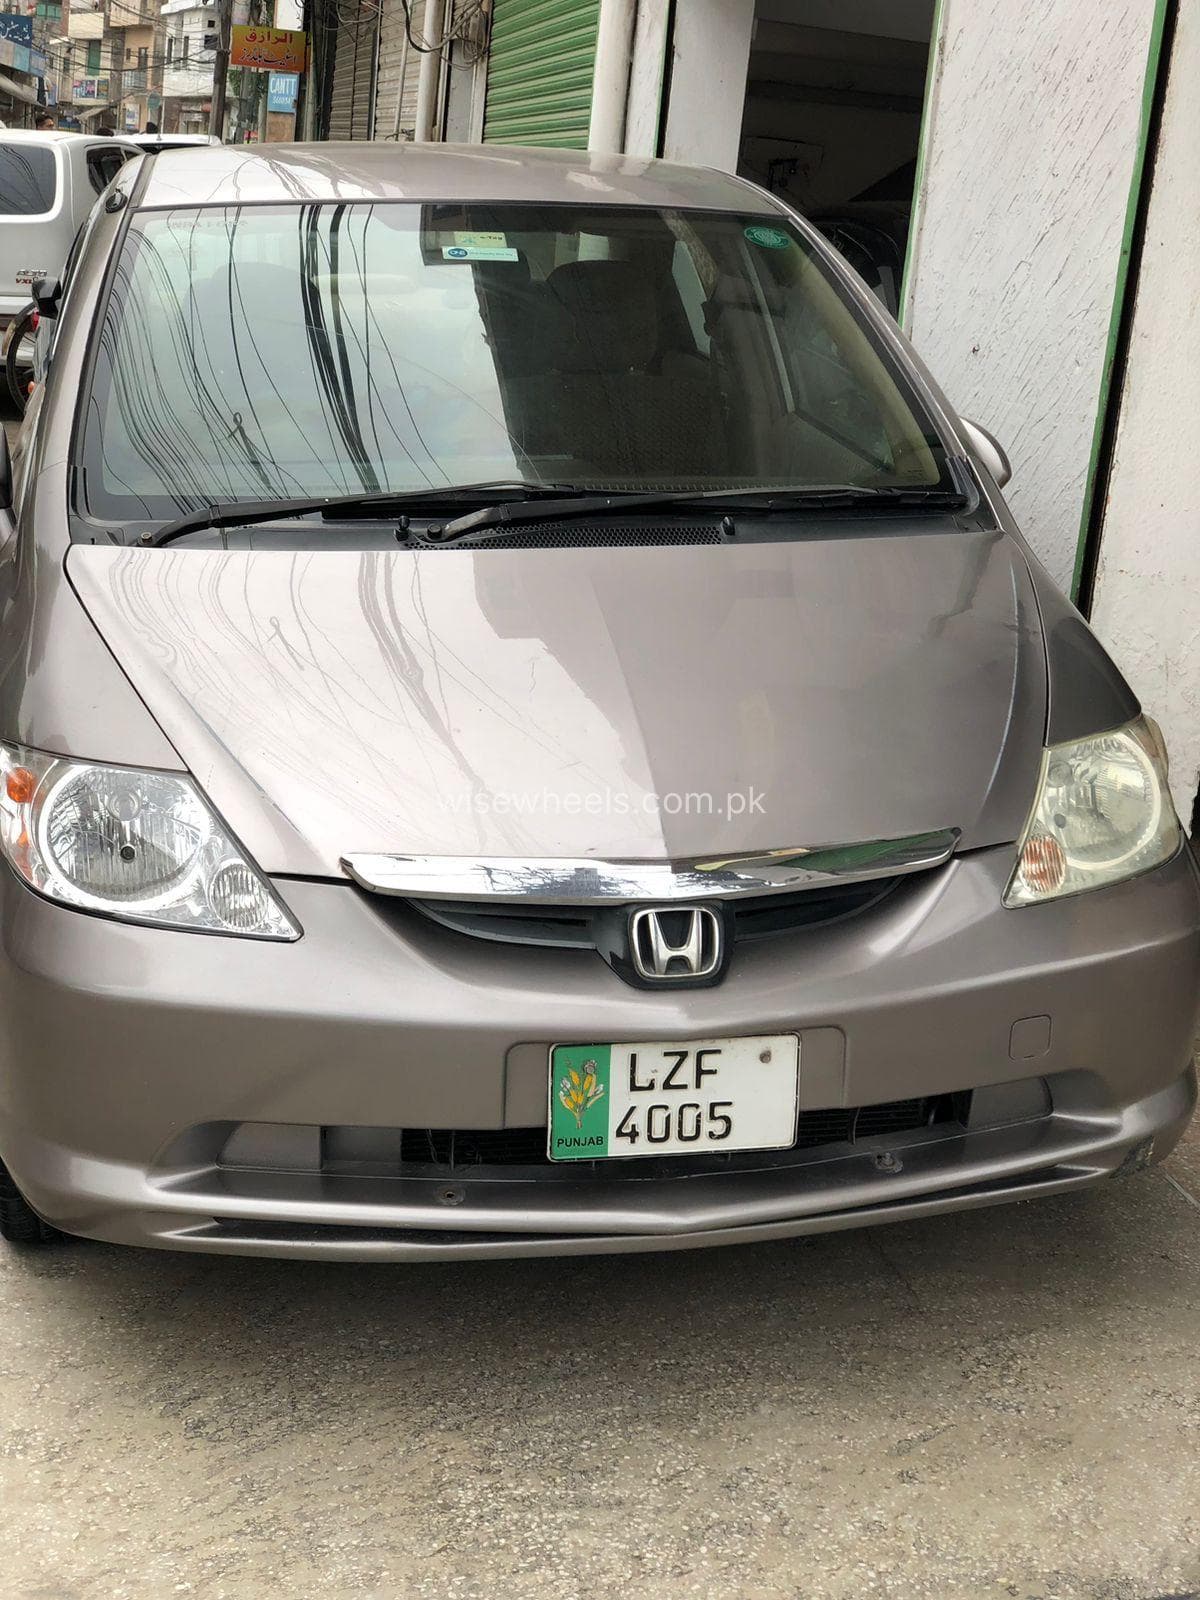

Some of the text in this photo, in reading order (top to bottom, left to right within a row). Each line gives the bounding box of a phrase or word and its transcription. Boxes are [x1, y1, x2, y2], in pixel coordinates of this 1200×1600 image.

[270, 78, 297, 95] CANTT
[629, 1048, 722, 1093] LZF
[615, 1101, 733, 1145] 4005
[557, 1135, 604, 1148] PUNJAB
